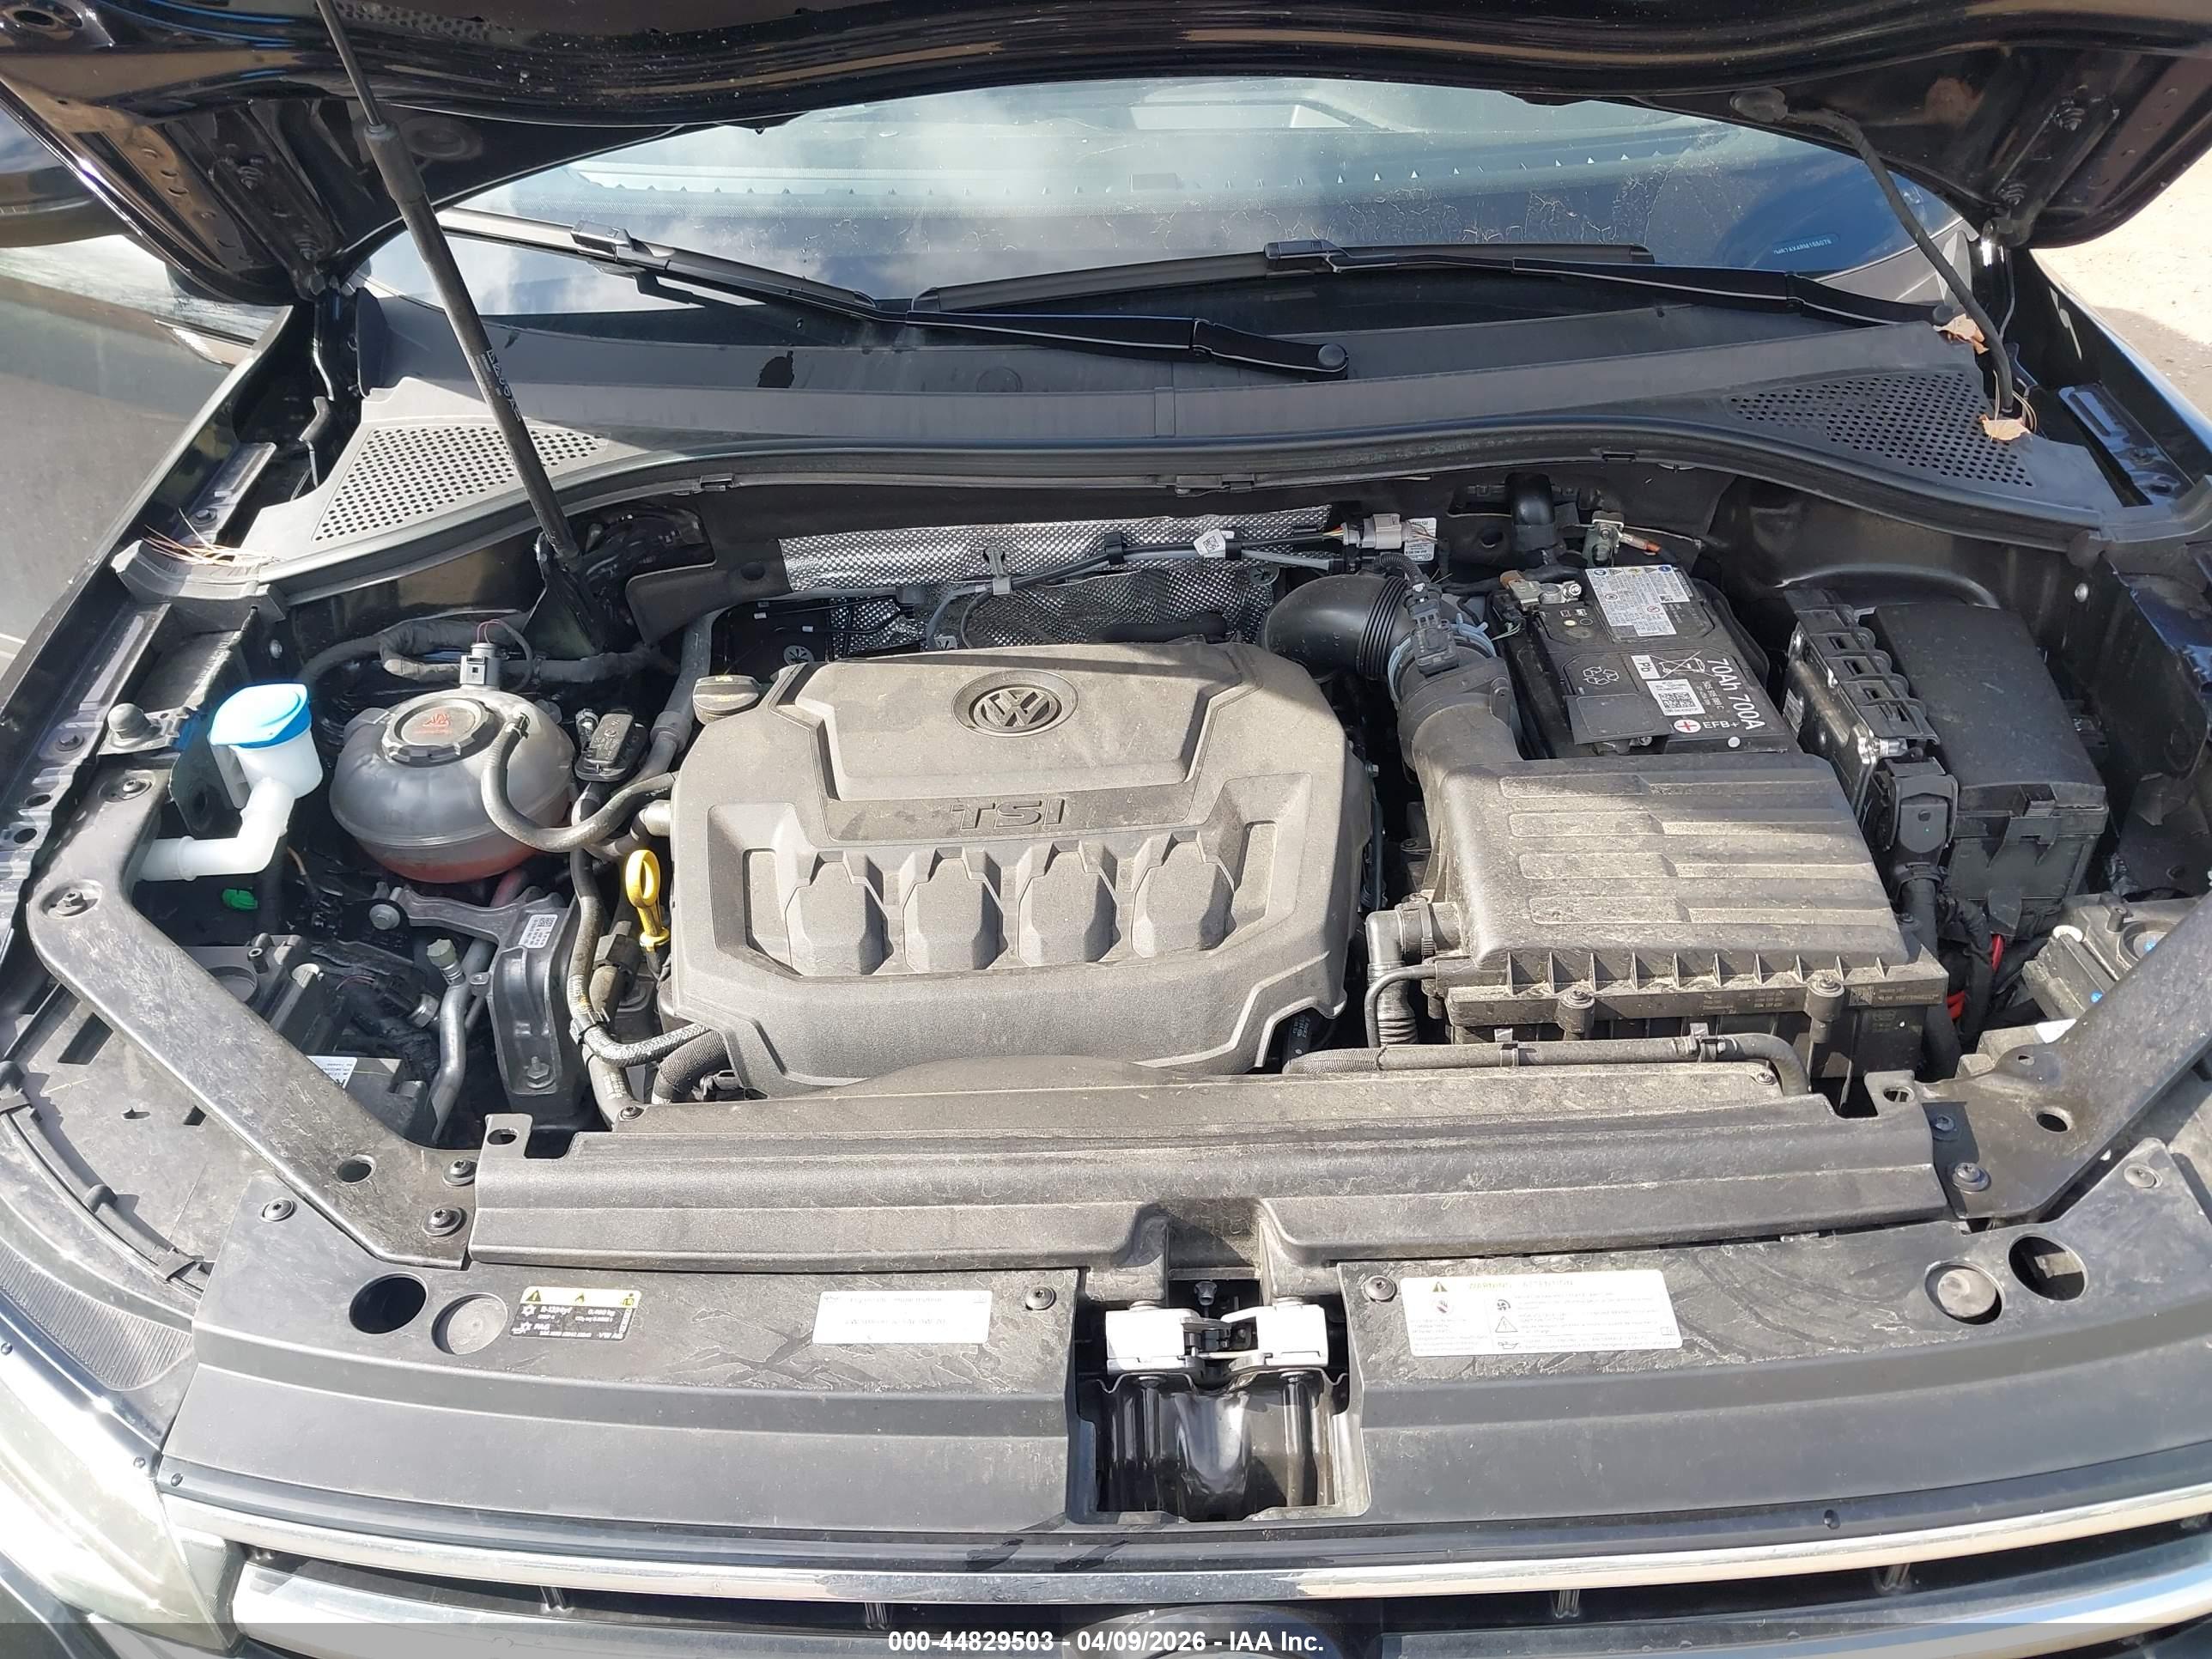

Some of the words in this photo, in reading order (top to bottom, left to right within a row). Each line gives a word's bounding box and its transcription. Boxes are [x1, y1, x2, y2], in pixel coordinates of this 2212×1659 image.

[1638, 662, 1651, 672] Pb
[975, 687, 1061, 732] VW
[1707, 658, 1742, 691] 70Ah
[1728, 694, 1765, 730] 700A
[1703, 720, 1741, 729] EFB+
[951, 798, 1066, 830] TSI
